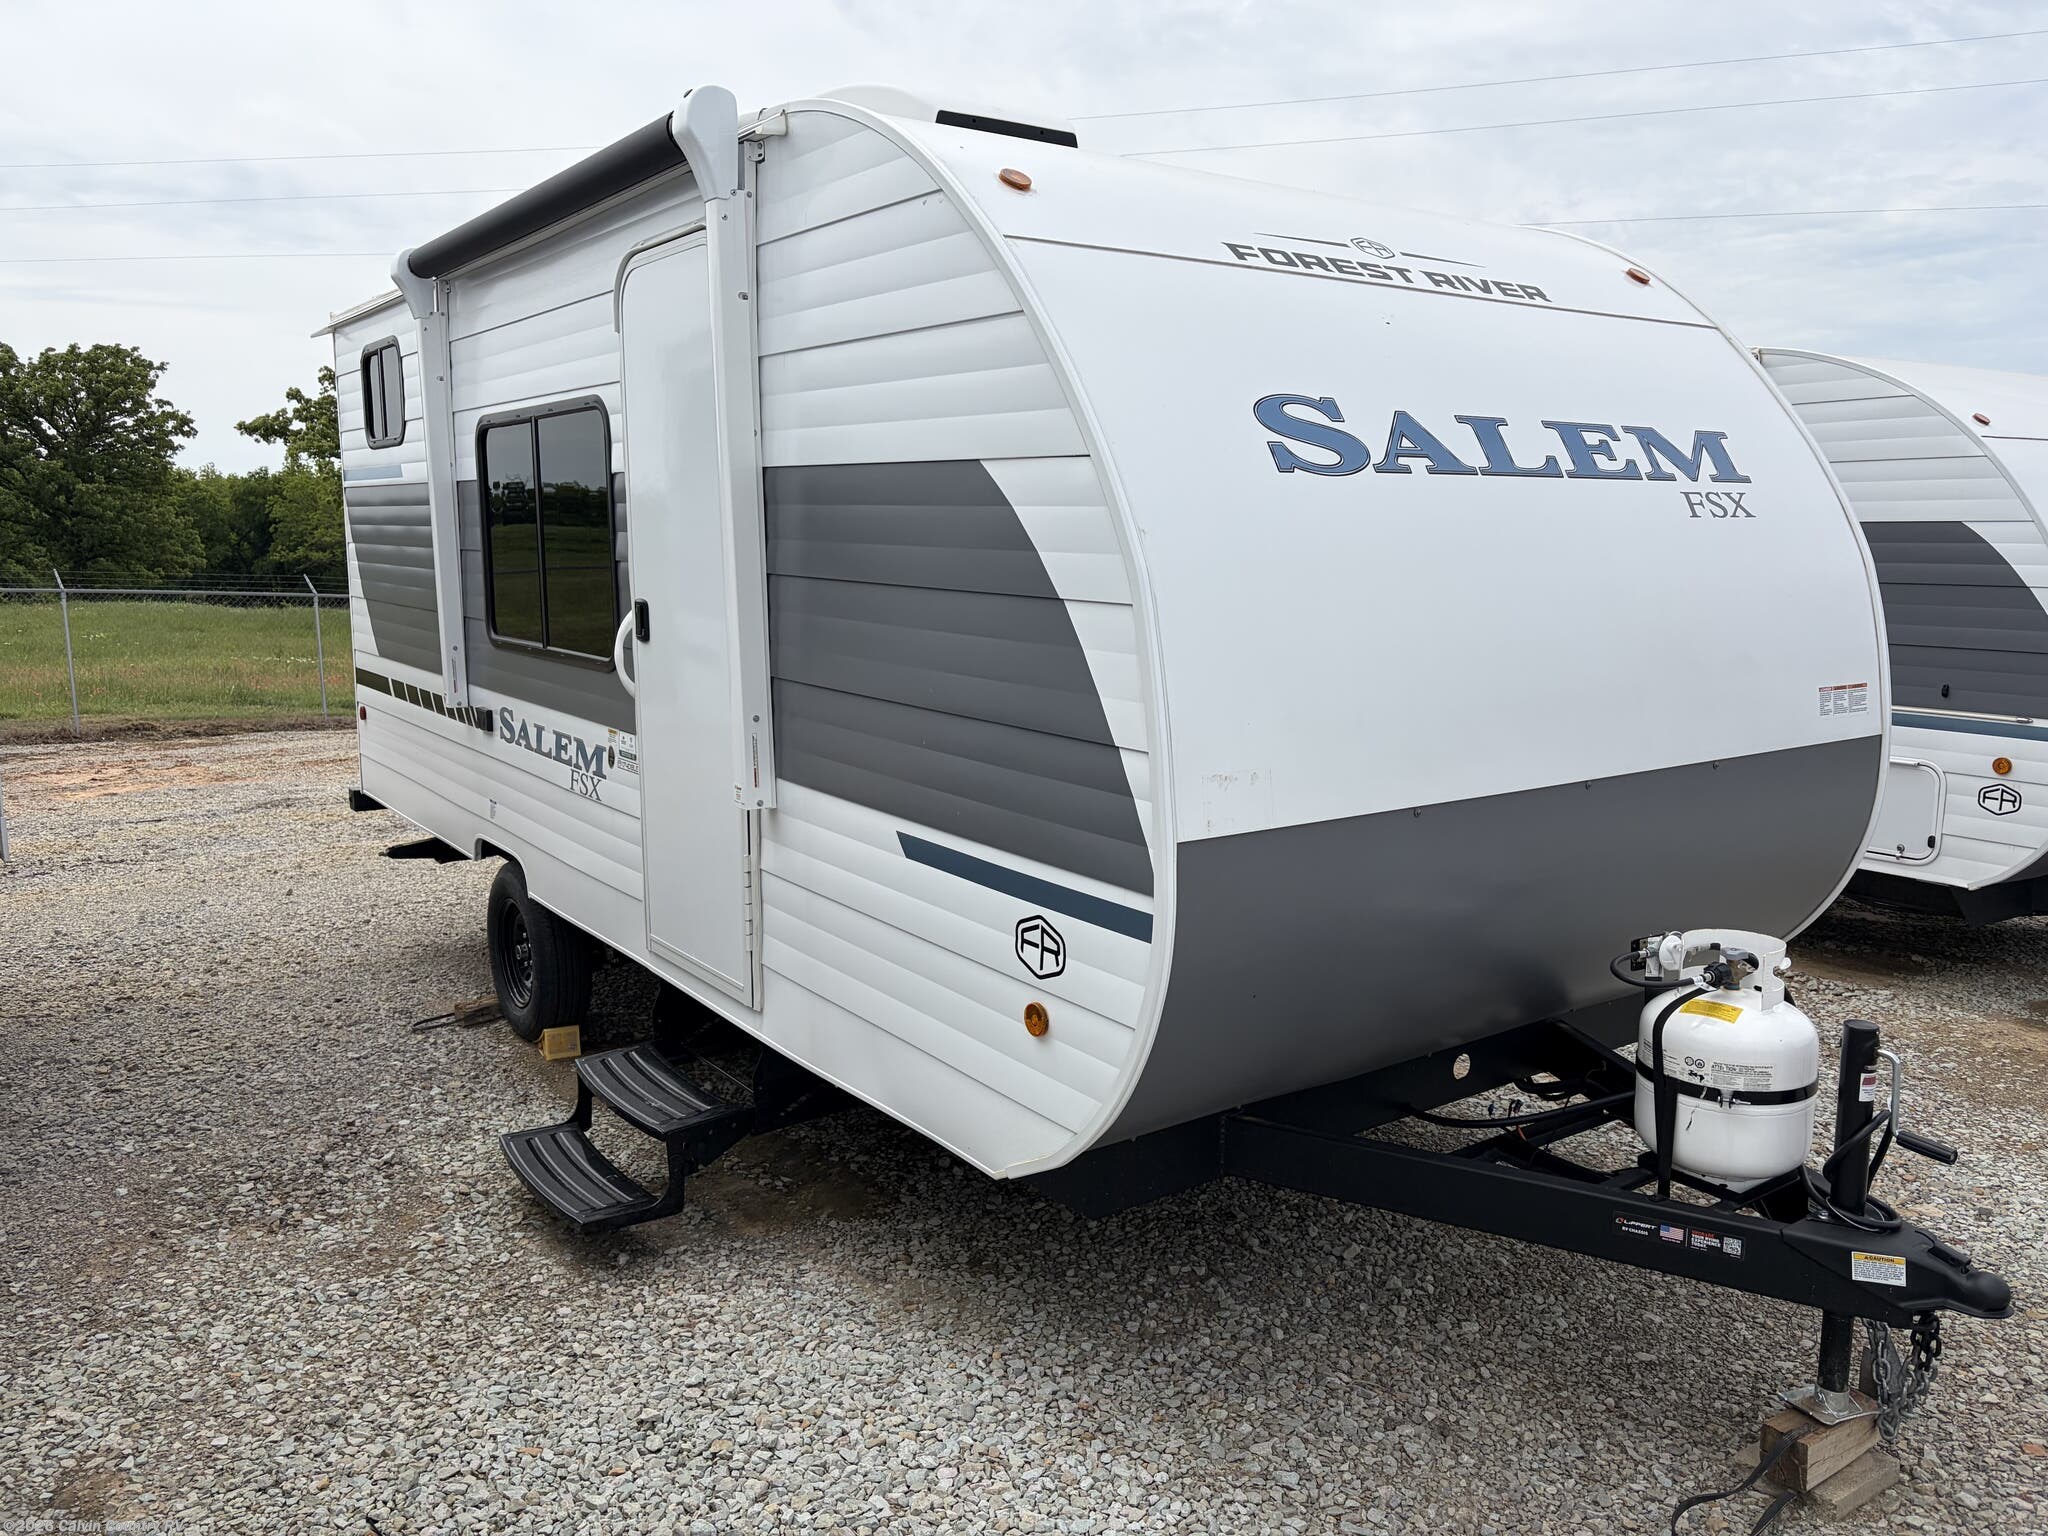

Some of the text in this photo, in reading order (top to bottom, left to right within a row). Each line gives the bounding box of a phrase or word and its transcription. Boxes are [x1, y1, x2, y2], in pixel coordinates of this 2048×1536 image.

[1221, 242, 1553, 302] FOREST RIVER
[1252, 393, 1752, 483] SALEM
[1679, 490, 1757, 519] FSX
[499, 706, 607, 780] SALEM
[569, 768, 602, 802] FSX
[1983, 788, 2018, 812] FR
[1020, 923, 1061, 972] FR
[1869, 1255, 1895, 1263] CAUTION
